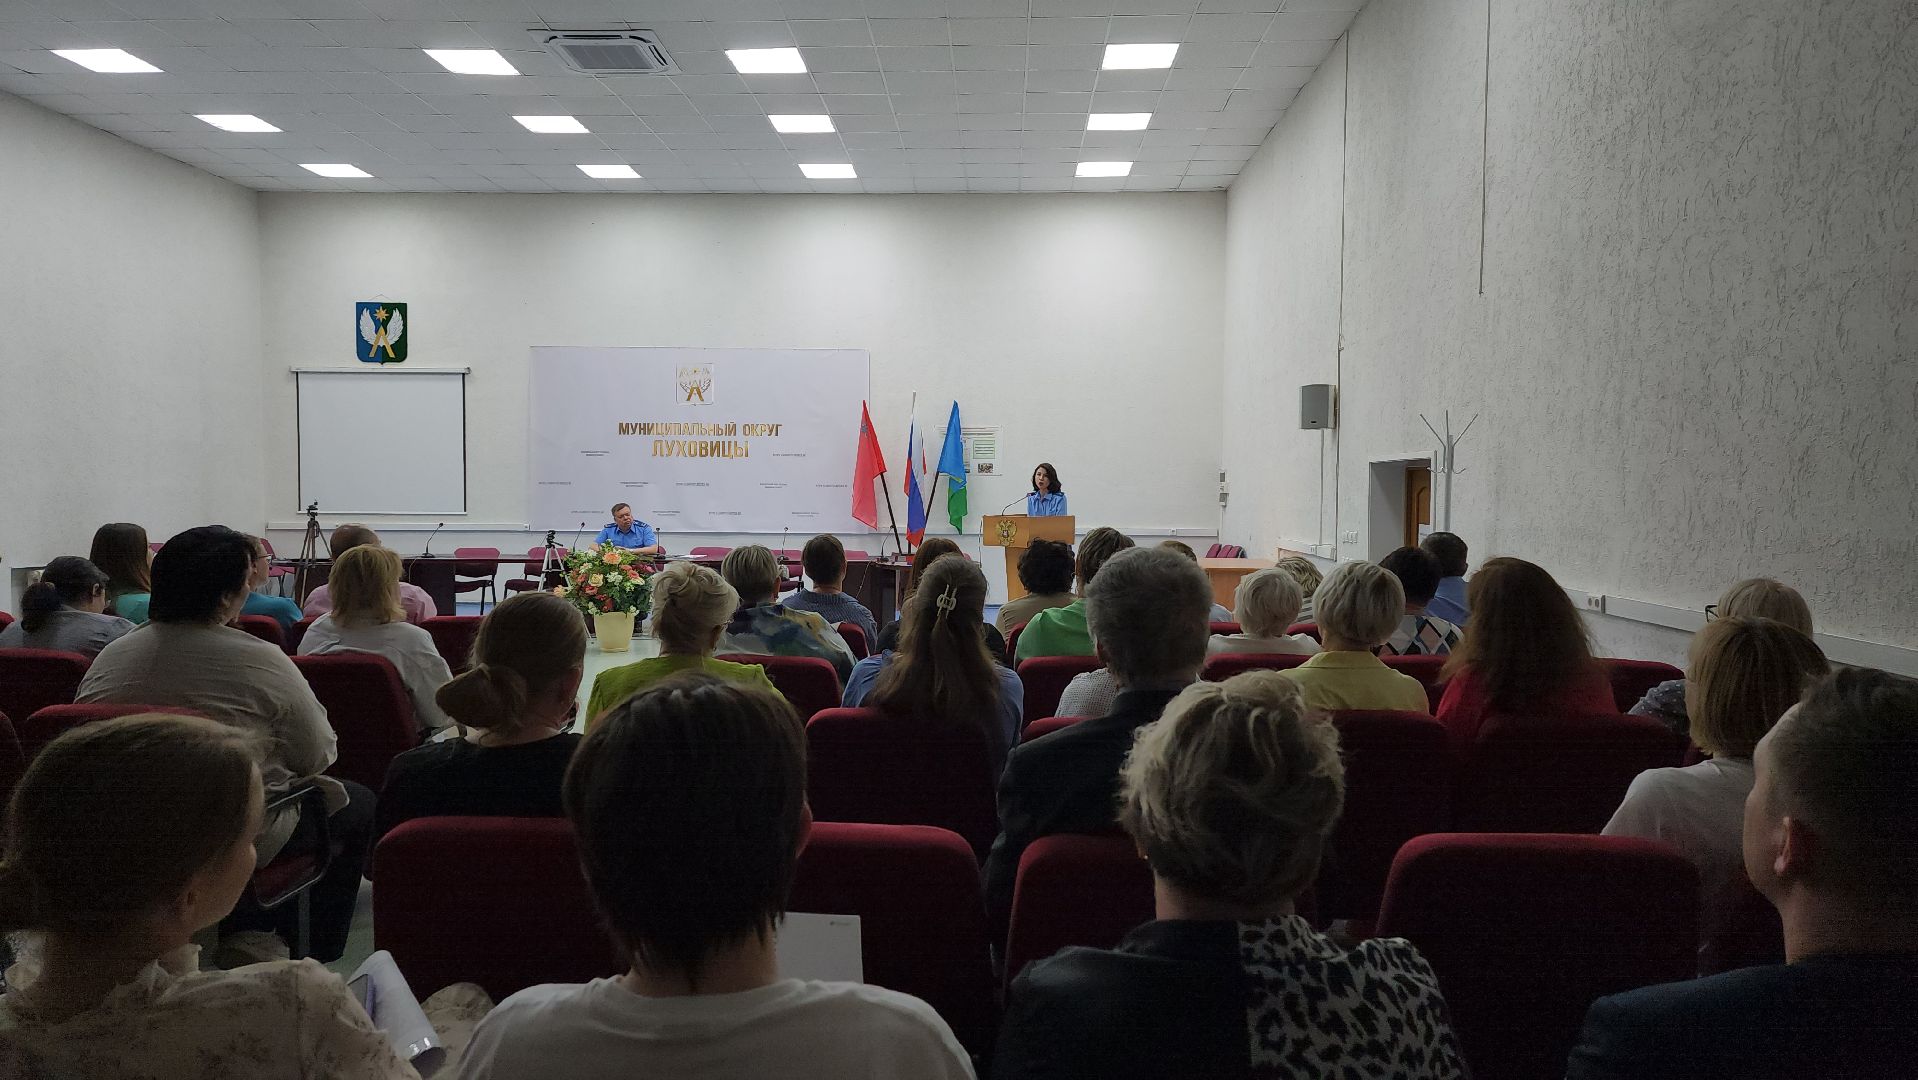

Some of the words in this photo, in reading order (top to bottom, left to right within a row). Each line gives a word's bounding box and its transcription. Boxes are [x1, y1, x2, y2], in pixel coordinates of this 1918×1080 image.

[618, 421, 737, 437] МУНИЦИПАЛЬНЫЙ
[742, 423, 783, 437] ОКРУГ
[652, 440, 749, 459] ЛУХОВИЦЫ
